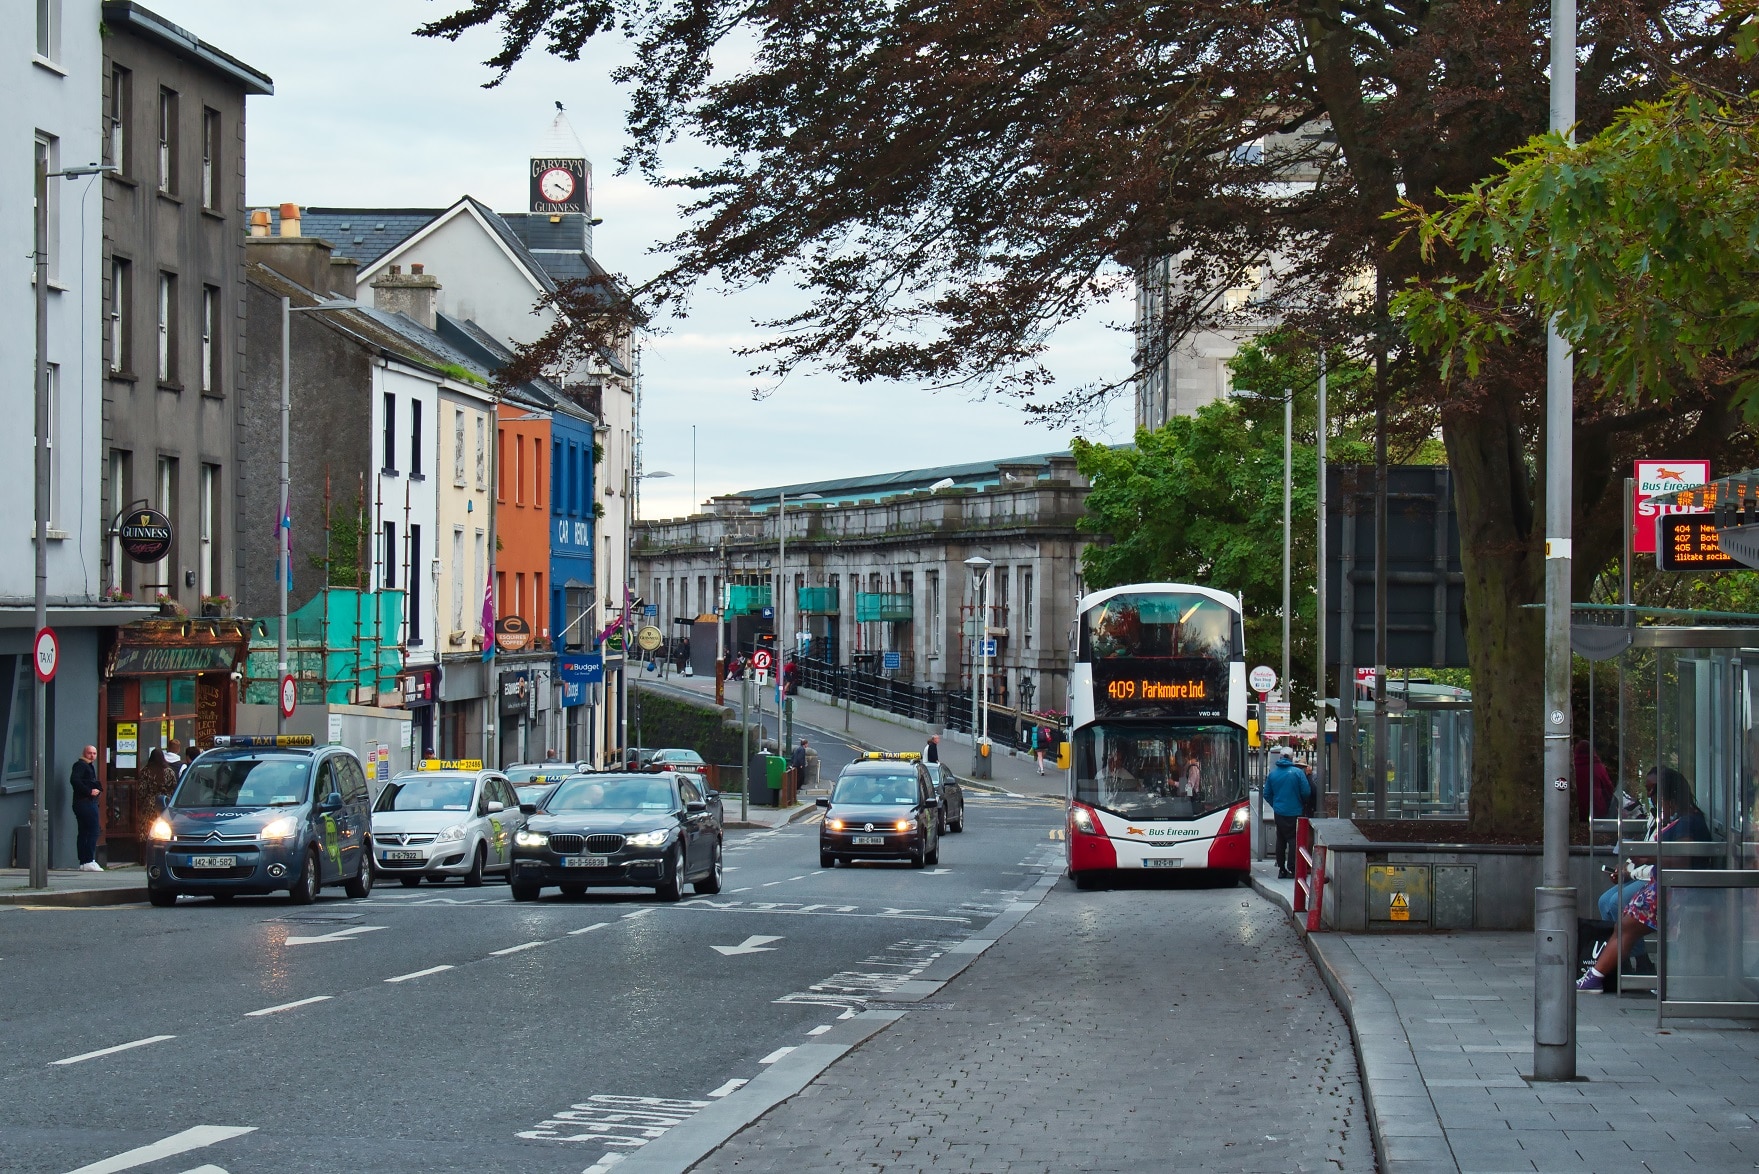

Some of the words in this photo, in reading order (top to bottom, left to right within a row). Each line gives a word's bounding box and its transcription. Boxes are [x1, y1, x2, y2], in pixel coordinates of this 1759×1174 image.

[532, 159, 583, 178] GARVEY'S
[535, 201, 580, 212] GUINNESS
[1642, 482, 1661, 491] Bus
[122, 525, 168, 539] GUINNESS
[558, 519, 569, 544] CAR
[574, 521, 589, 547] RENTAL
[1674, 524, 1691, 533] 404
[1674, 534, 1691, 542] 407
[1674, 543, 1691, 552] 405
[40, 652, 53, 664] TAXI
[142, 648, 214, 670] O'CONNELL'S
[574, 663, 599, 672] Budget
[1358, 667, 1376, 675] STO
[1108, 680, 1135, 698] 409
[1142, 680, 1188, 698] Parkmore
[1188, 680, 1206, 698] Ind.
[215, 737, 223, 746] G
[251, 736, 272, 746] TAXI
[286, 736, 310, 745] 34406
[420, 760, 427, 768] G
[440, 760, 461, 769] TAXI
[546, 775, 563, 783] TAXI
[1167, 827, 1200, 836] Éireann
